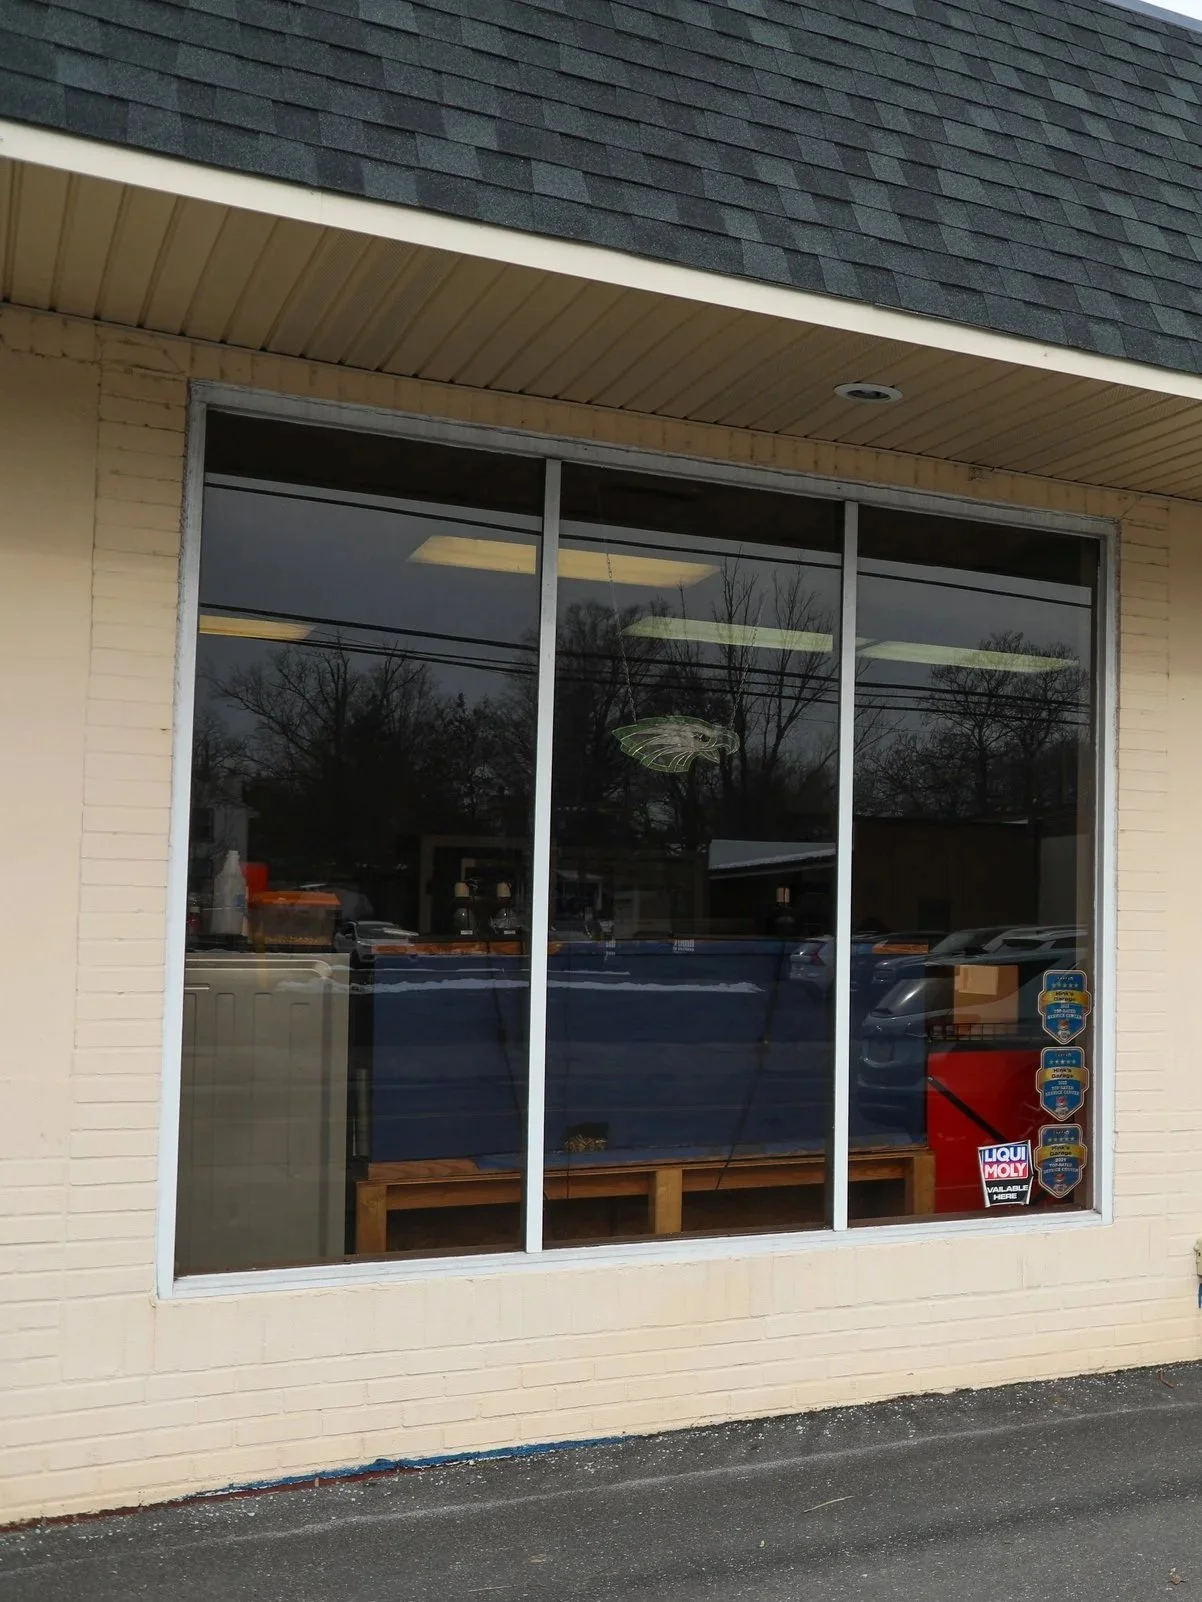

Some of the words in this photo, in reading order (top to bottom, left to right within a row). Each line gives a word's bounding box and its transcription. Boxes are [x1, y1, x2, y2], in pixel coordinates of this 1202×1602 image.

[984, 1146, 1026, 1163] LIQUI
[984, 1162, 1028, 1179] MOLY
[986, 1184, 1029, 1193] VAILABLE
[993, 1192, 1018, 1201] HERE
